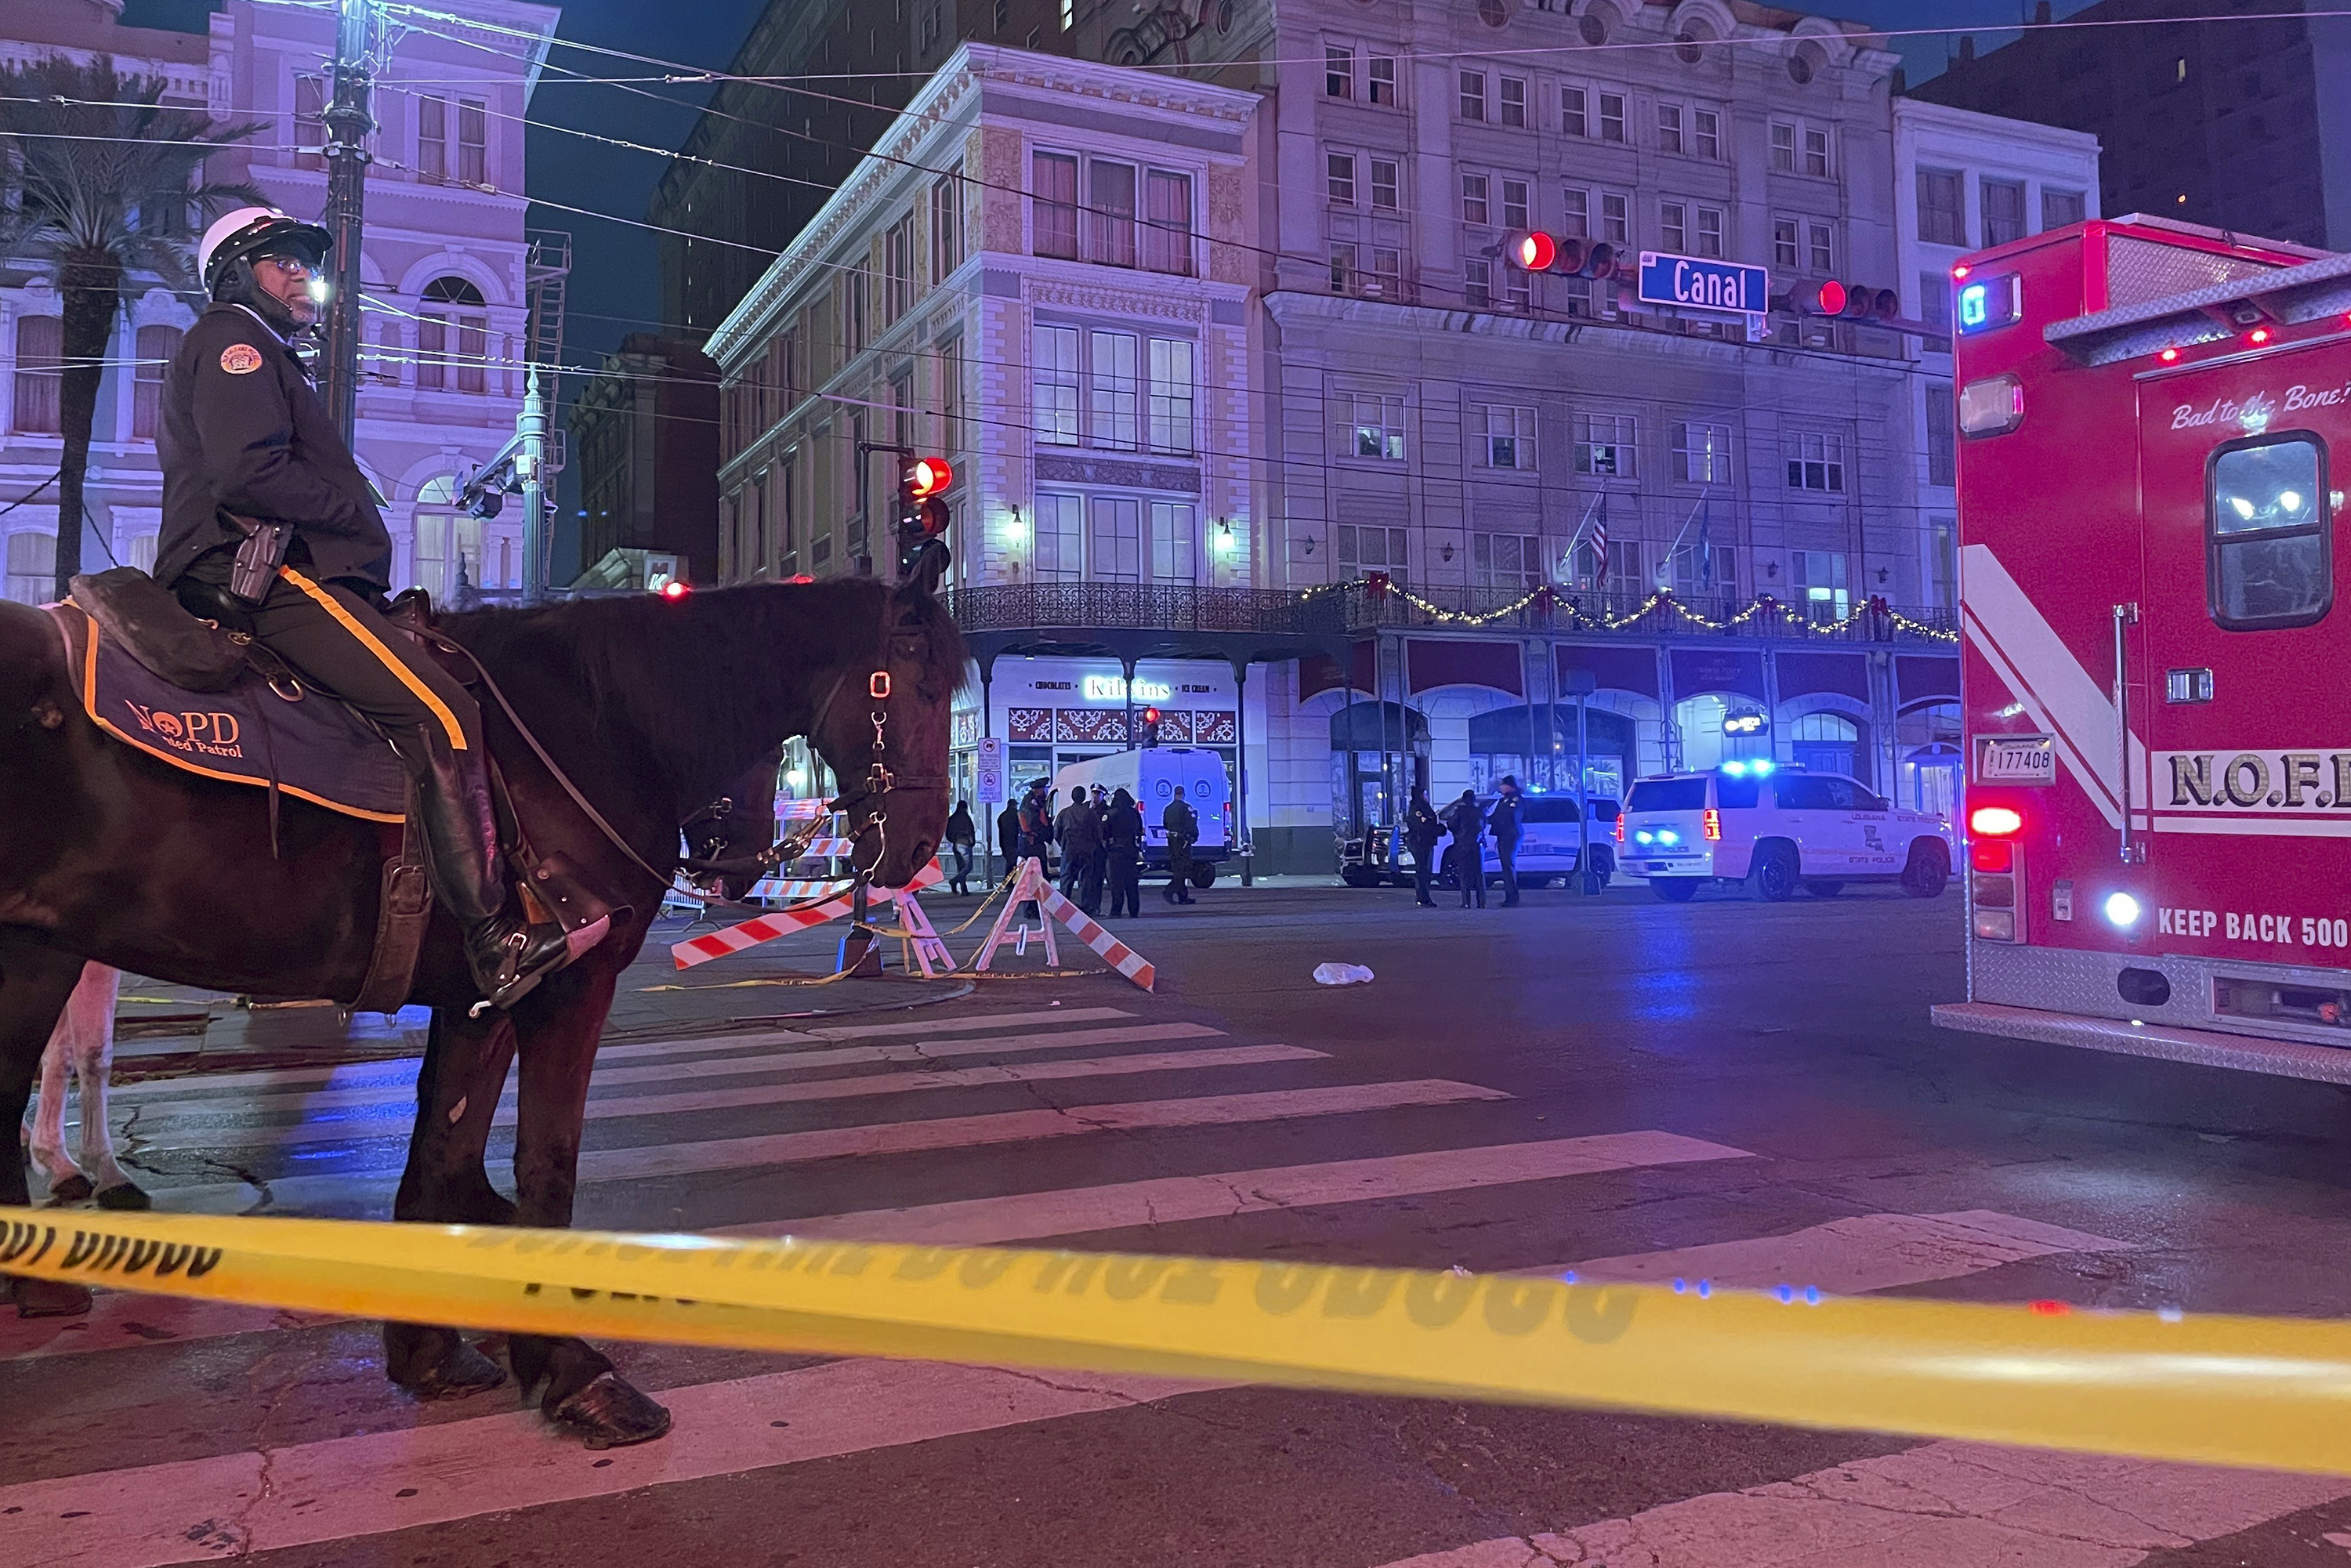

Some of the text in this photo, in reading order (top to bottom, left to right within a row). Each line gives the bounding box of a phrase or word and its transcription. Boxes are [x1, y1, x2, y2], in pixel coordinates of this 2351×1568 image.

[1675, 260, 1745, 309] Canal
[2171, 397, 2221, 429] Bad
[2220, 399, 2239, 422] to
[1035, 681, 1071, 690] CHOCOLATES
[1182, 684, 1210, 693] ICE CREAM
[125, 700, 240, 744] NOPD
[196, 741, 244, 758] Patrol
[1998, 751, 2050, 769] 177408
[2158, 907, 2349, 948] KEEP BACK 500
